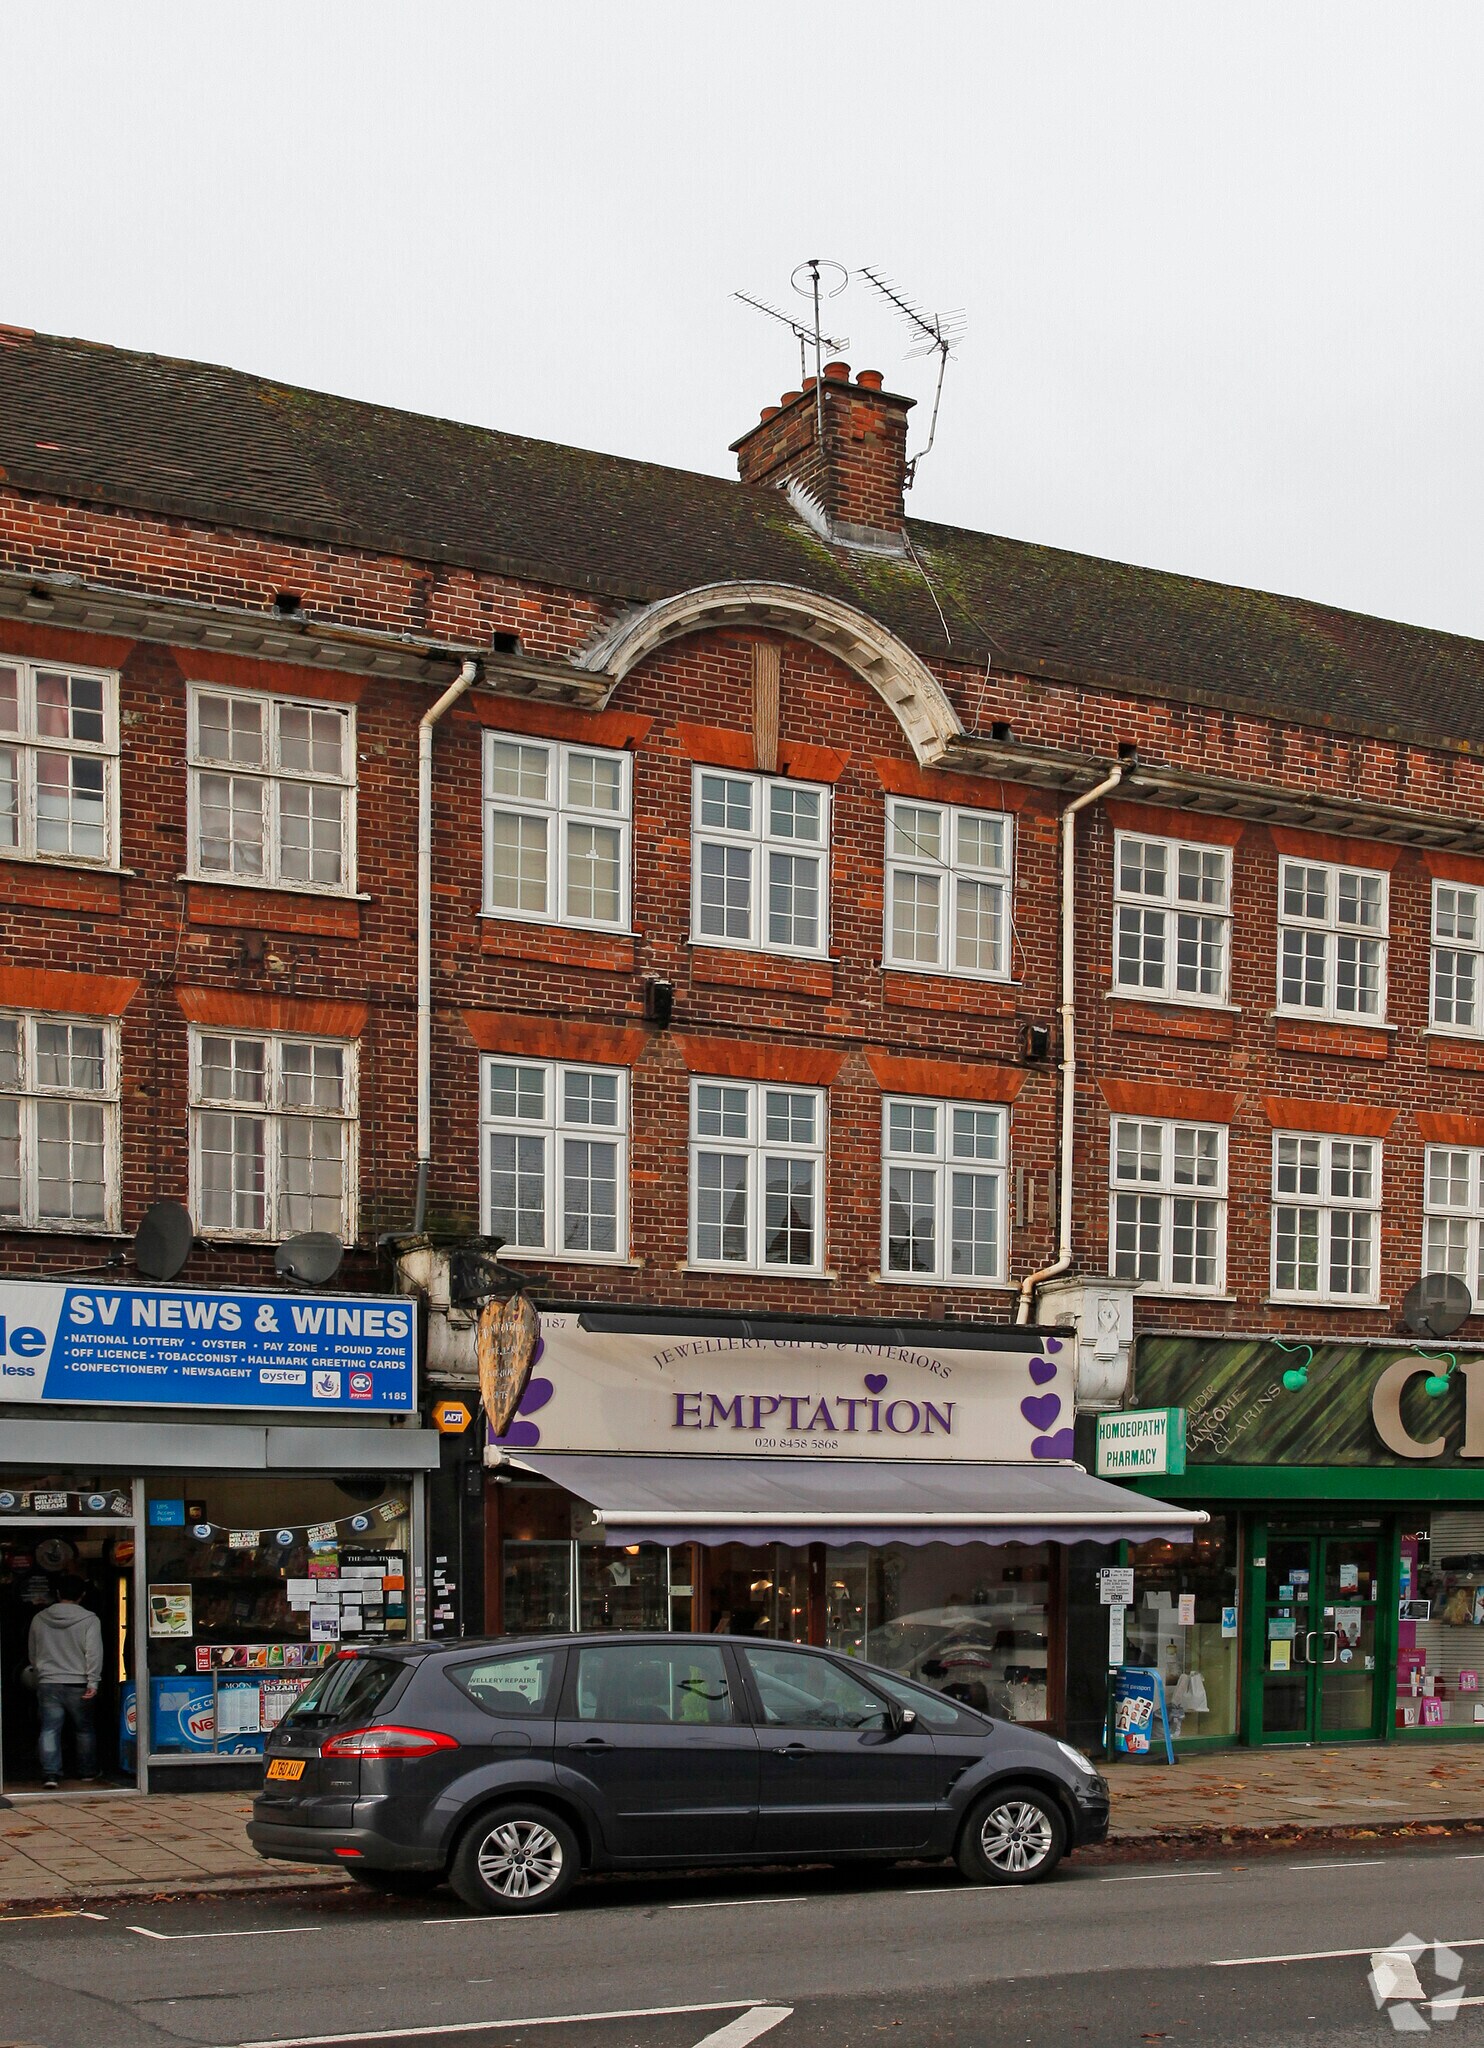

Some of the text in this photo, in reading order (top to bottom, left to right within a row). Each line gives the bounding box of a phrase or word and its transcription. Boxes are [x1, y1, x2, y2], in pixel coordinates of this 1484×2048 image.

[69, 1295, 409, 1338] SV NEWS & WINES
[71, 1334, 406, 1356] NATIONAL LOTTERY OYSTER PAY ZONE POUND ZONE
[71, 1348, 406, 1369] OFF LICENCE TOBACCONIST HALLMARK GREETING CARDS
[855, 1344, 952, 1378] INTERIORS
[2, 1364, 35, 1376] less
[71, 1363, 252, 1378] CONFECTIONERY NEWSAGENT
[262, 1371, 300, 1382] oyster
[382, 1392, 407, 1400] 1185
[1186, 1384, 1217, 1424] AUDER
[445, 1413, 463, 1422] ADT
[672, 1391, 956, 1434] EMPTATION
[1214, 1383, 1281, 1455] CLARINS
[1099, 1419, 1166, 1440] HOMOEOPATHY
[755, 1438, 838, 1449] 020 8458 5868
[1106, 1448, 1157, 1467] PHARMACY
[263, 1684, 297, 1692] bazaar
[189, 1703, 202, 1712] ICE
